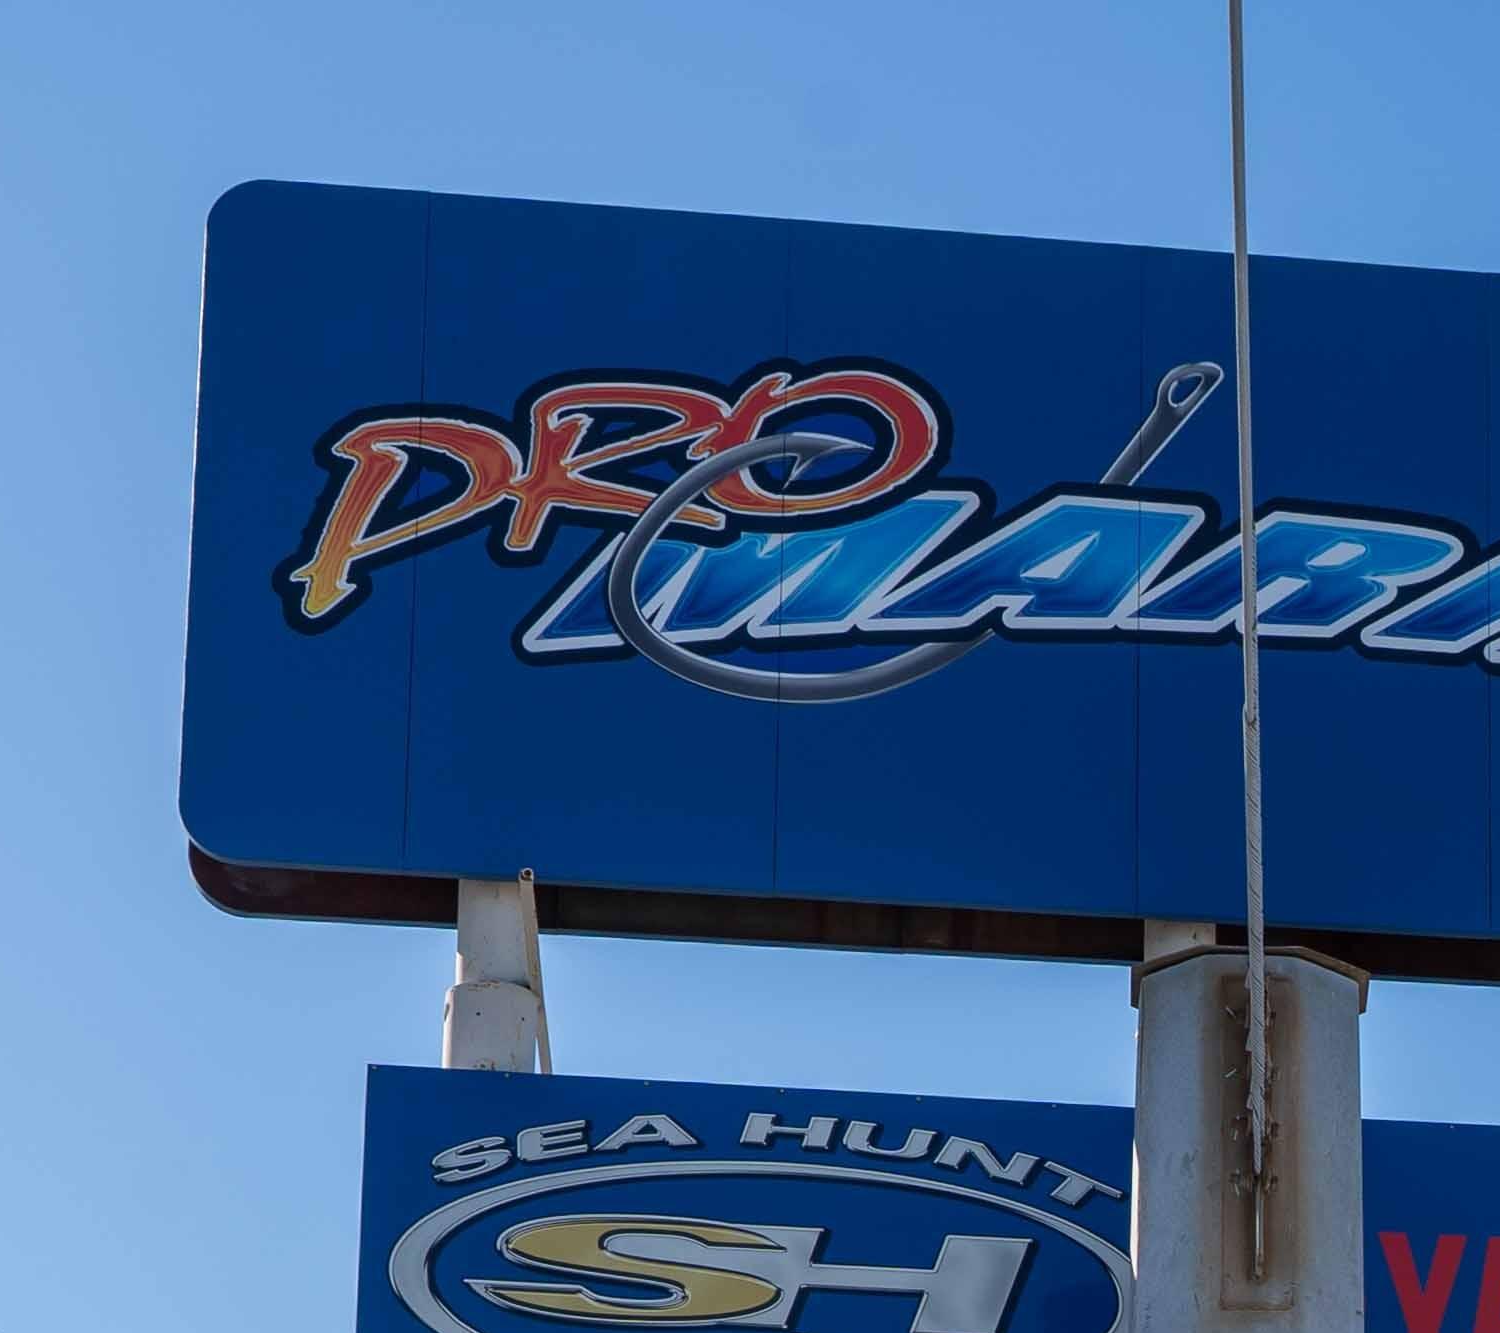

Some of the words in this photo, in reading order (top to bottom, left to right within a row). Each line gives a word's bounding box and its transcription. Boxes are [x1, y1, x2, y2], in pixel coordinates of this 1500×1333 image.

[286, 364, 948, 622] PRO
[432, 1113, 700, 1183] SEA
[739, 1112, 1124, 1206] HUNT
